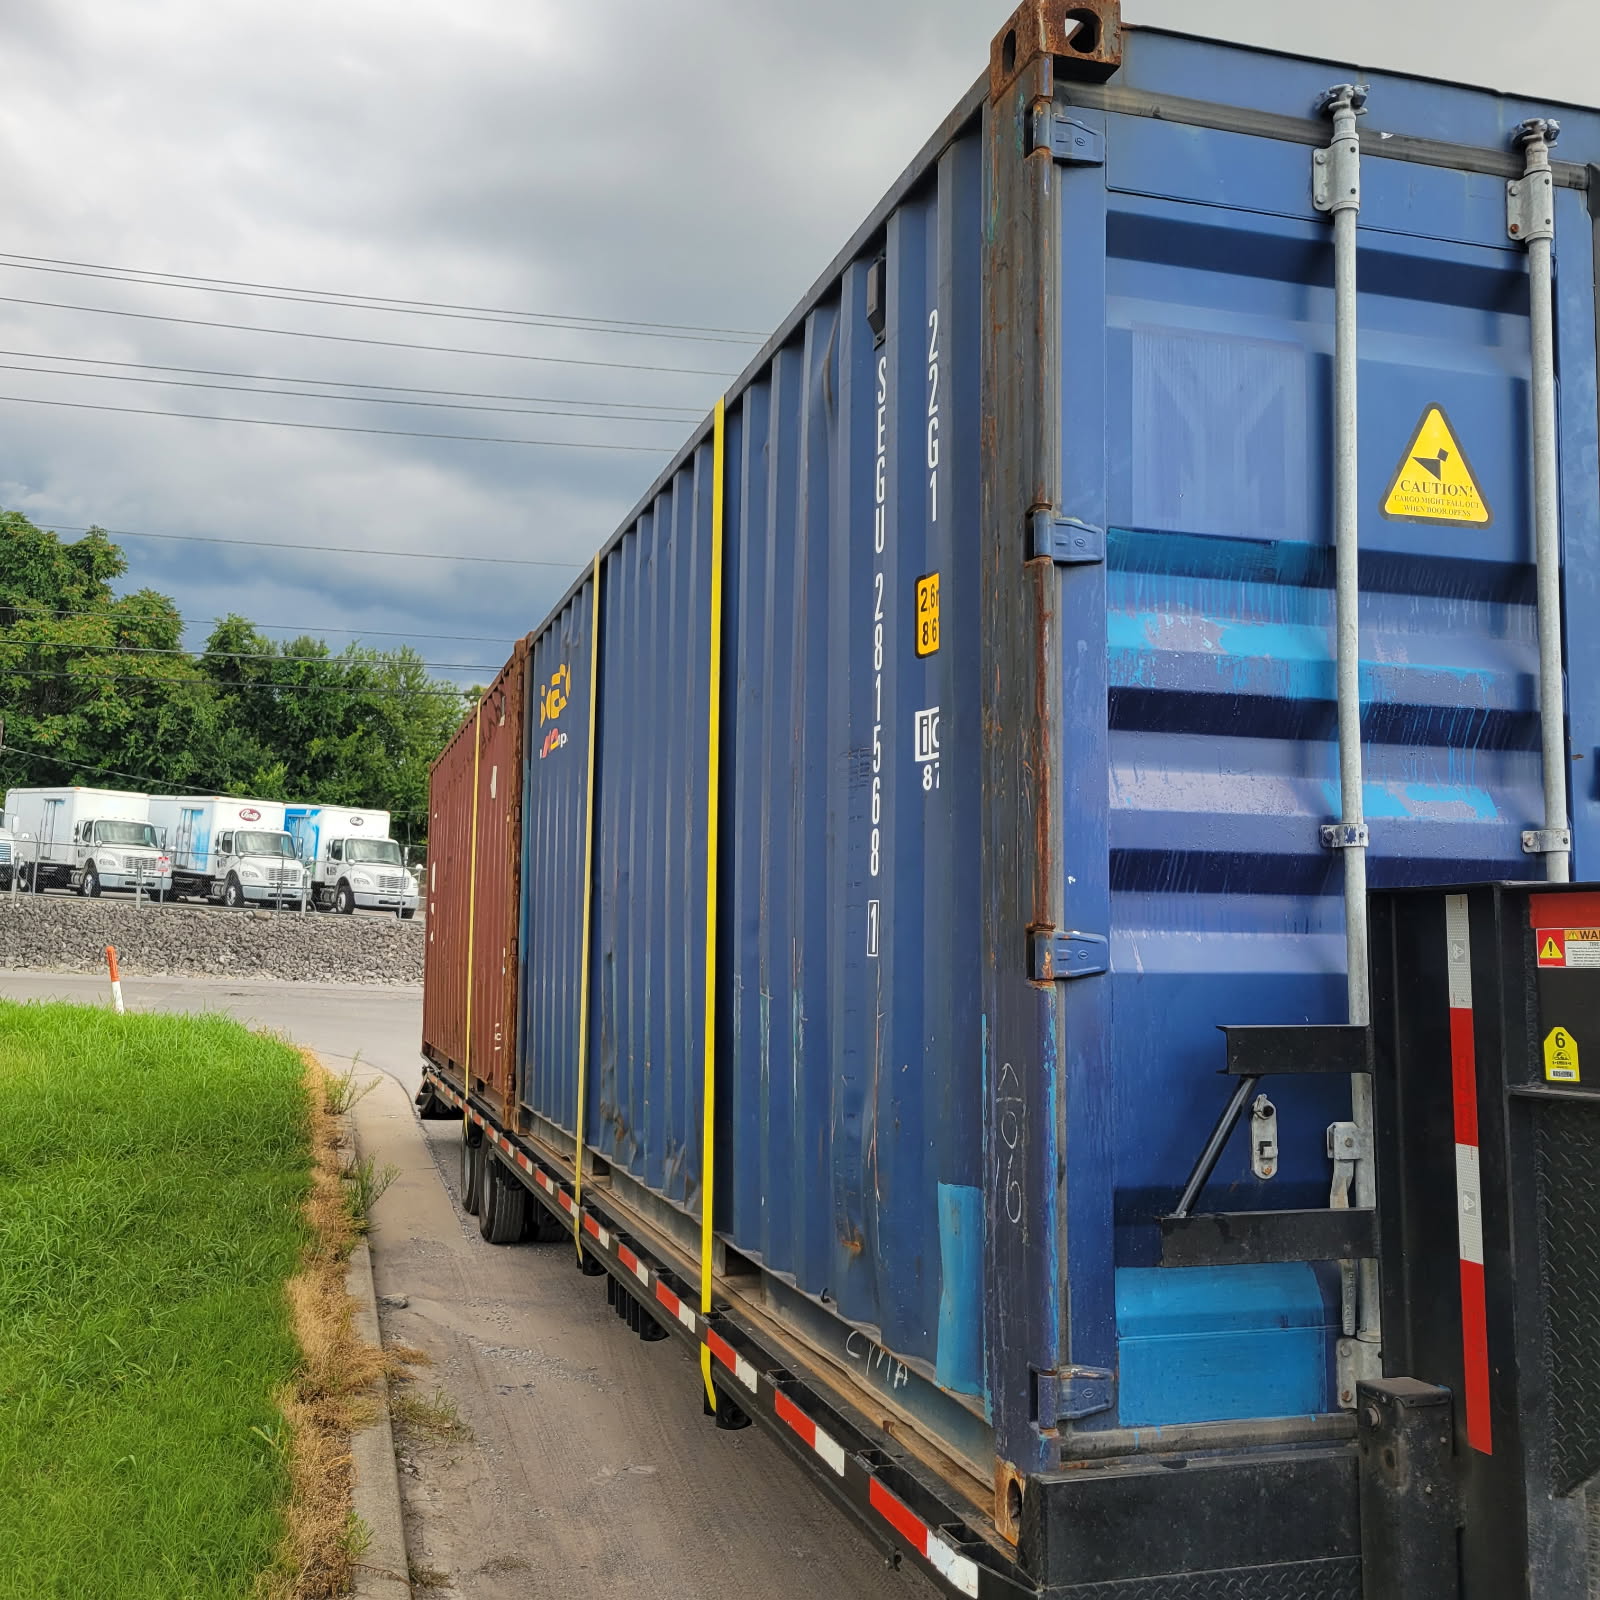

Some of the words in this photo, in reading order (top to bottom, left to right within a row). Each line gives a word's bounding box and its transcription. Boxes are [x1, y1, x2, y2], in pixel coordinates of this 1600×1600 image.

[928, 309, 939, 522] 22G1
[873, 356, 887, 554] SEGU
[1400, 480, 1473, 498] CAUTION!
[1394, 494, 1420, 504] CARGO
[1421, 496, 1445, 506] MIGHT
[1446, 499, 1464, 508] FALL
[1465, 501, 1480, 509] OUT
[1426, 506, 1447, 515] DOOR
[1448, 508, 1471, 517] OPENS
[870, 572, 884, 877] 281568
[1579, 930, 1600, 940] WA
[1555, 1031, 1566, 1049] 6
